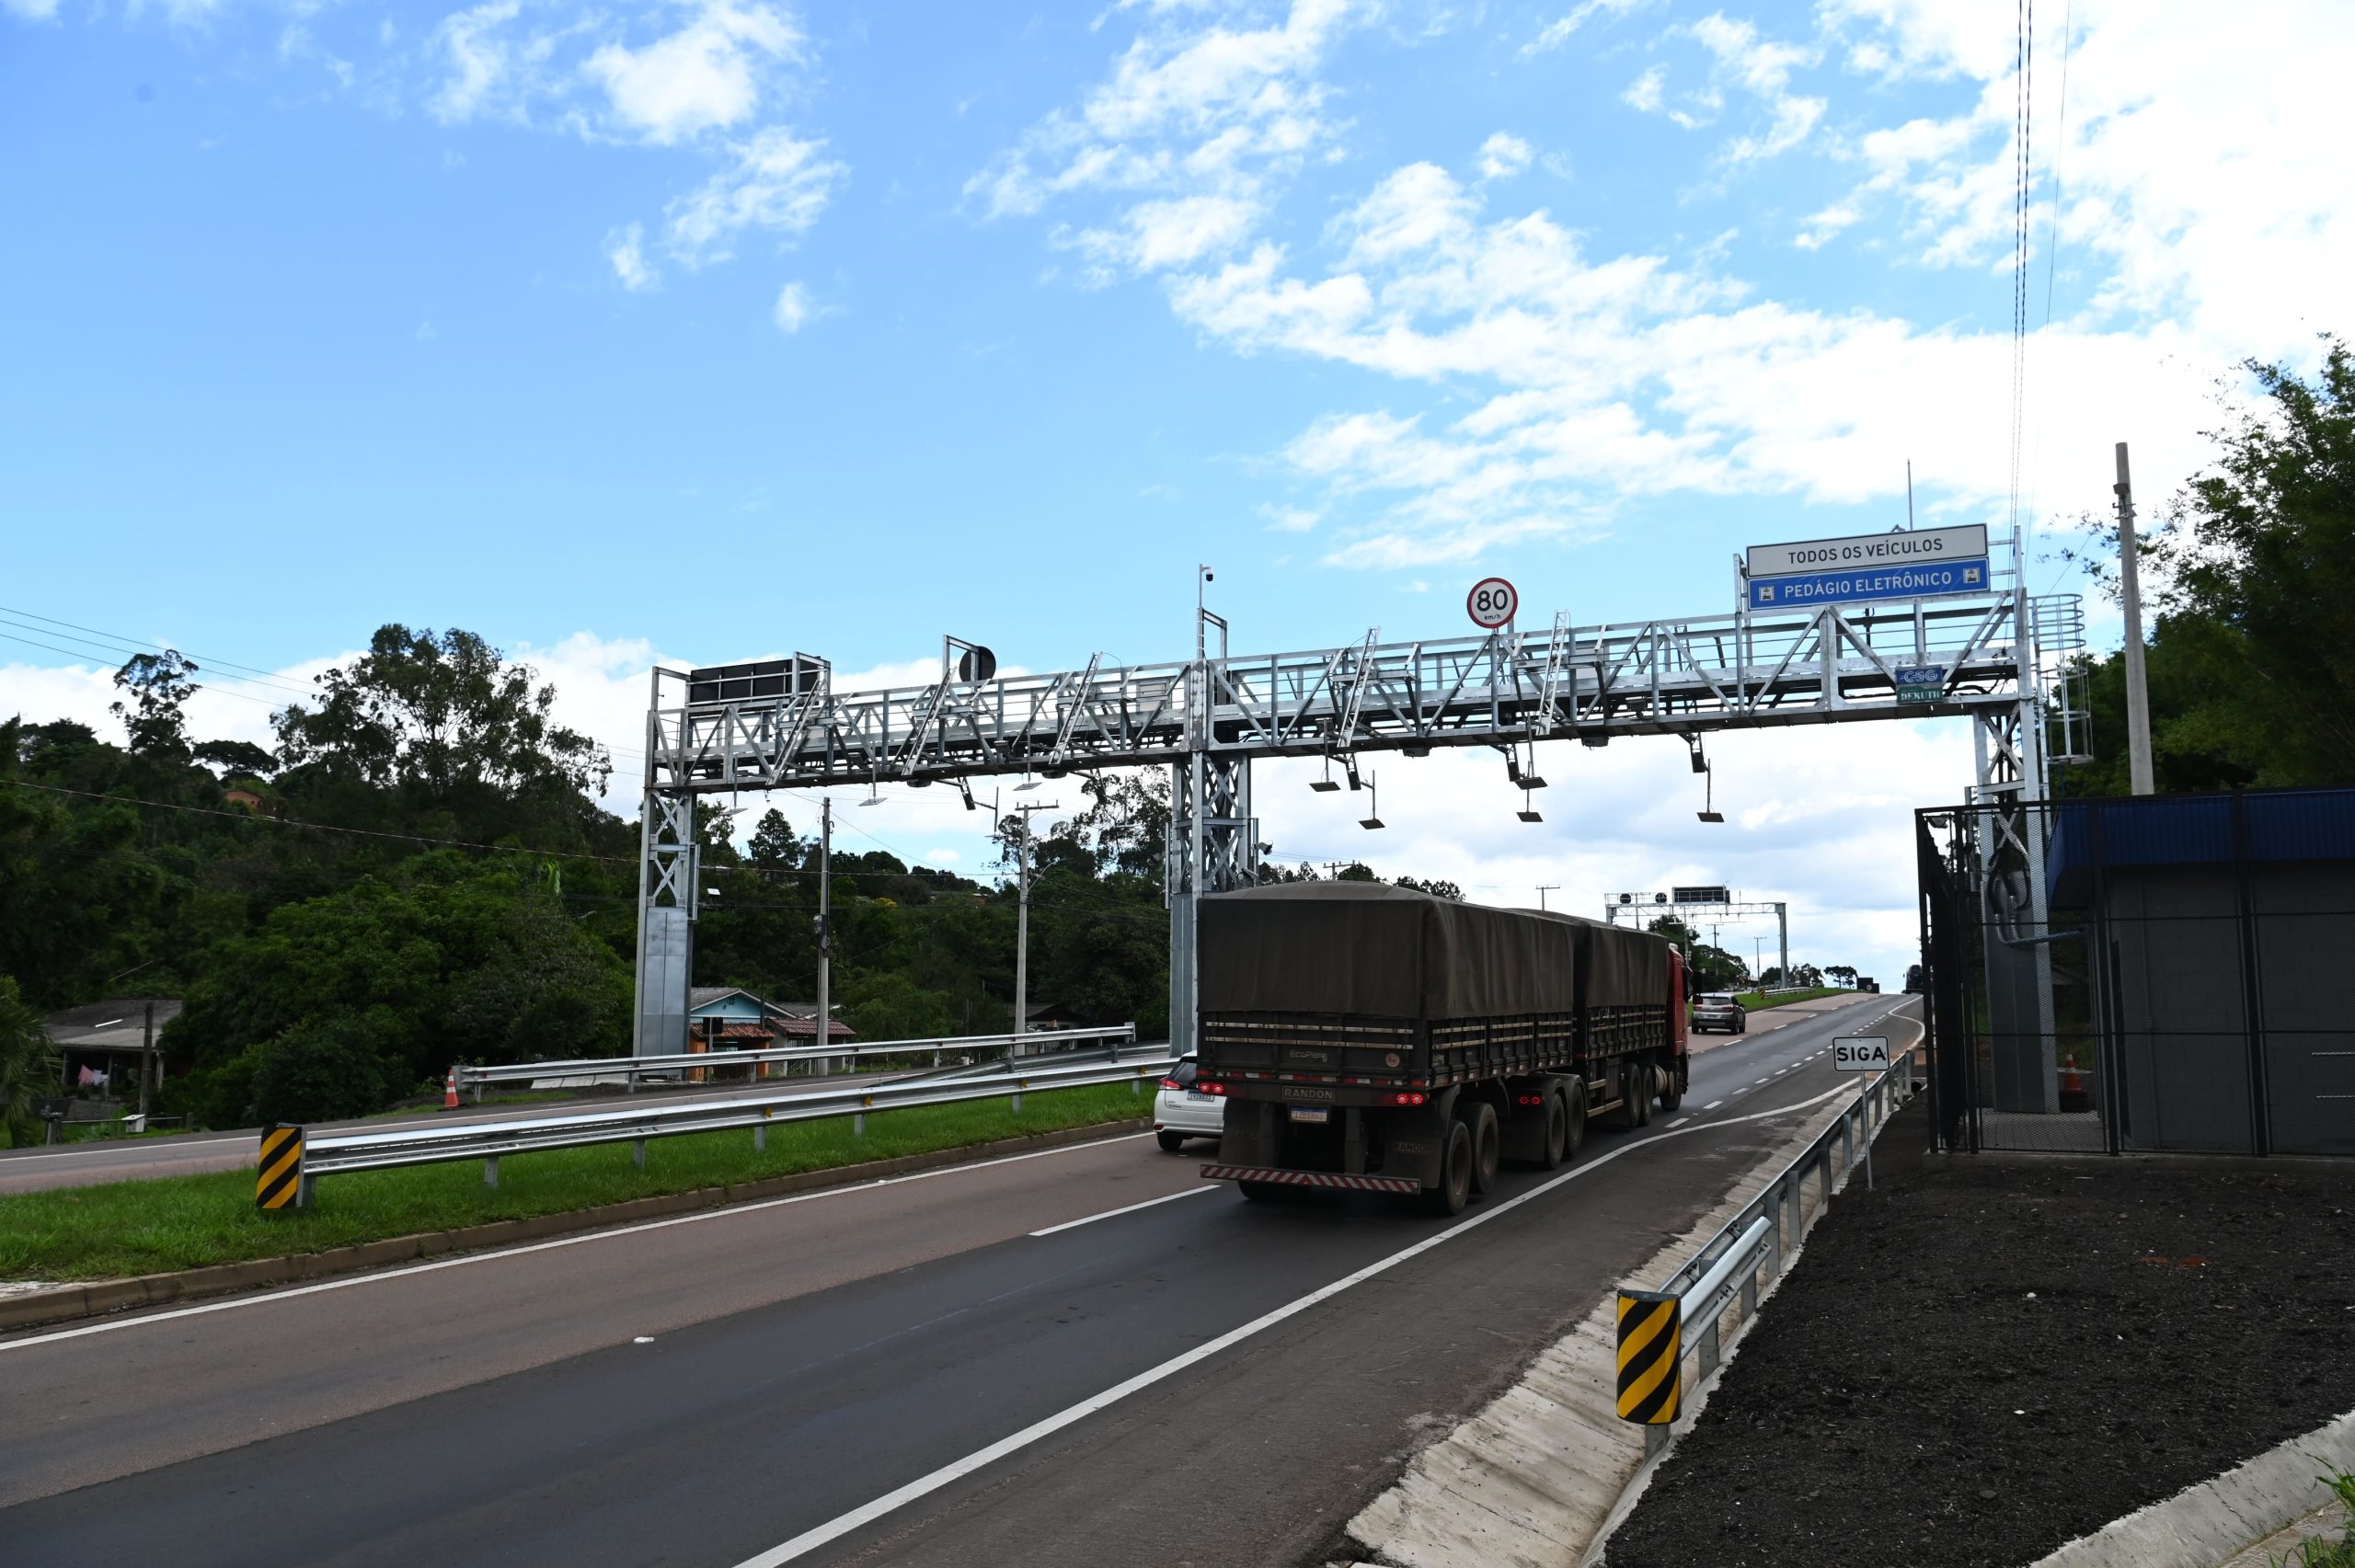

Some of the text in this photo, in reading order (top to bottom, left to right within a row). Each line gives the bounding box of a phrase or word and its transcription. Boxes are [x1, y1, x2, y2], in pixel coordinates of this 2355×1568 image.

[1788, 538, 1944, 565] TODOS OS VEÍCULOS
[1785, 571, 1952, 598] PEDÁGIO ELETRÔNICO
[1476, 589, 1509, 612] 80
[1903, 669, 1938, 683] CSG
[1836, 1047, 1887, 1062] SIGA
[1284, 1088, 1333, 1099] RANDON
